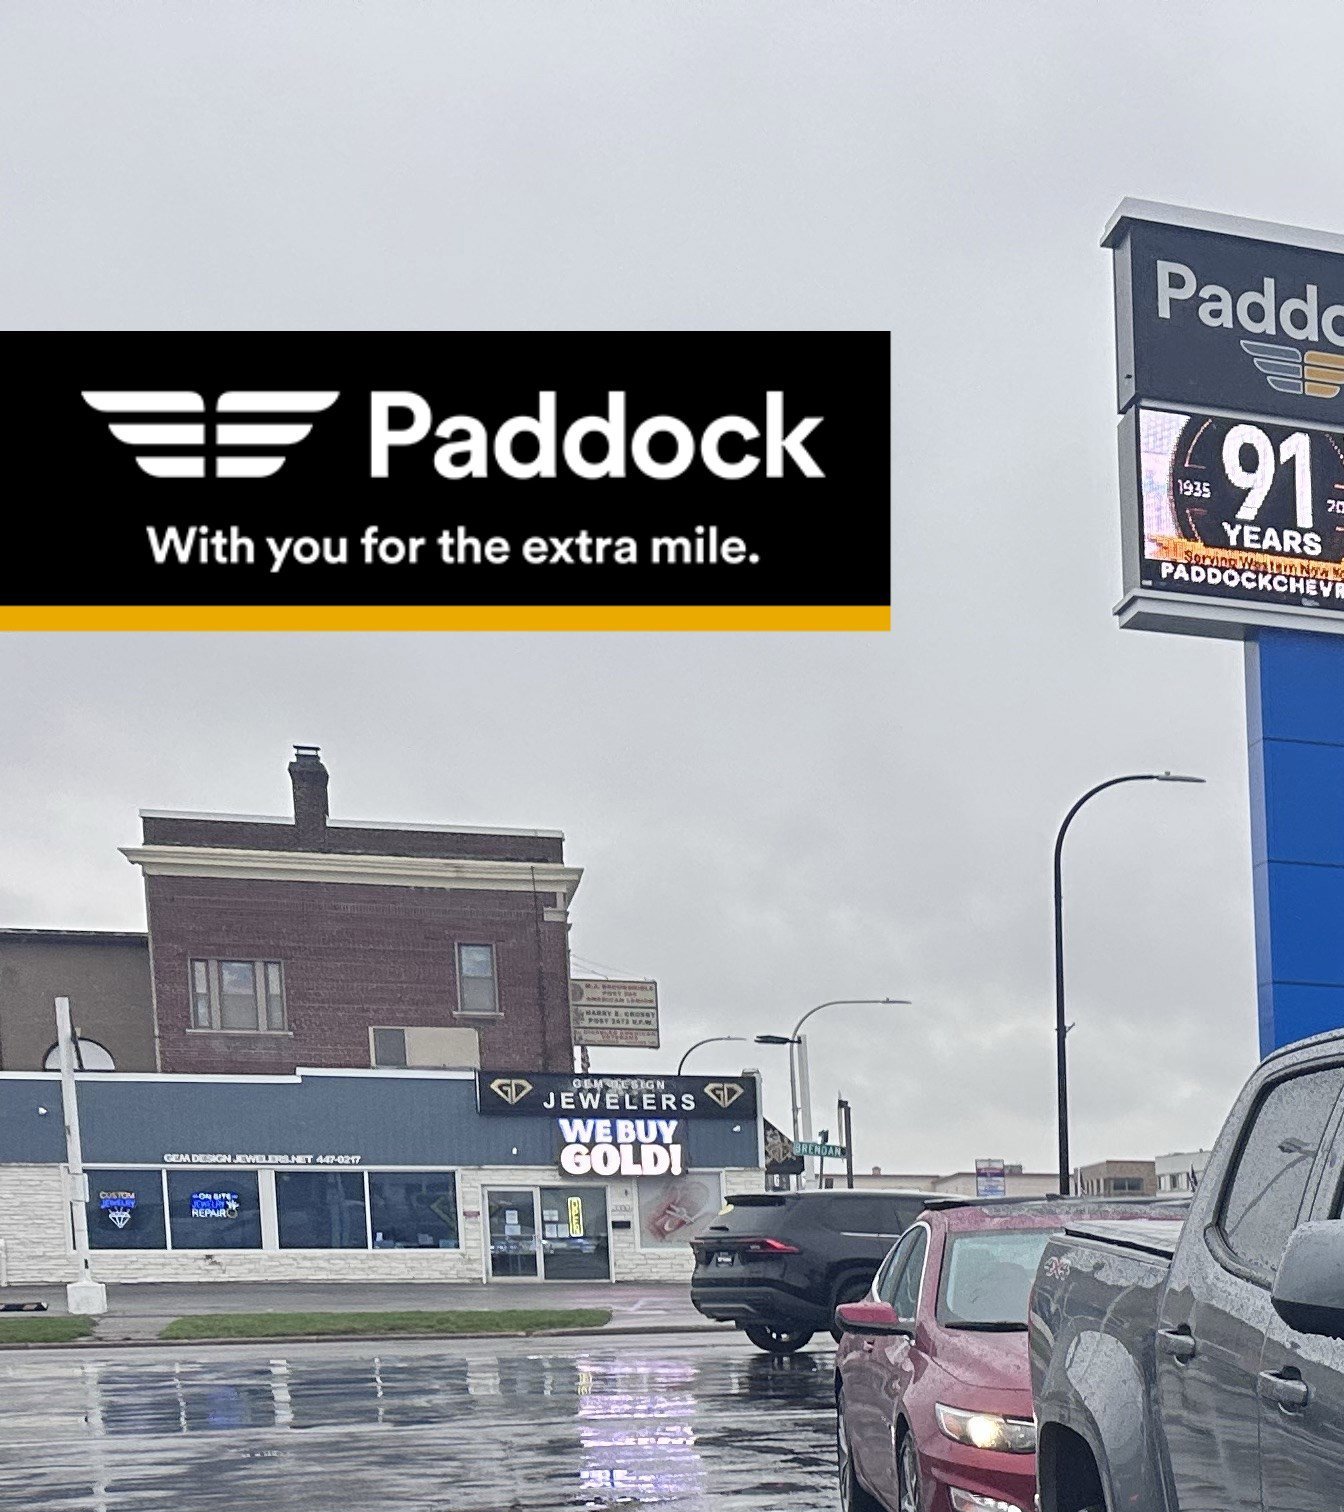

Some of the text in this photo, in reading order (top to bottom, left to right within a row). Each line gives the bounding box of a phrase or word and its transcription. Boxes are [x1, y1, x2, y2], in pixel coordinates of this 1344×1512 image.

[1222, 423, 1314, 529] 91
[1177, 478, 1212, 499] 1935
[1222, 521, 1323, 556] YEARS
[543, 1092, 696, 1111] JEWELERS
[558, 1118, 678, 1143] WE BUY
[164, 1154, 191, 1163] GEM
[560, 1143, 682, 1176] GOLD!
[794, 1142, 842, 1157] BRENDAN
[192, 1208, 227, 1218] REPAIR
